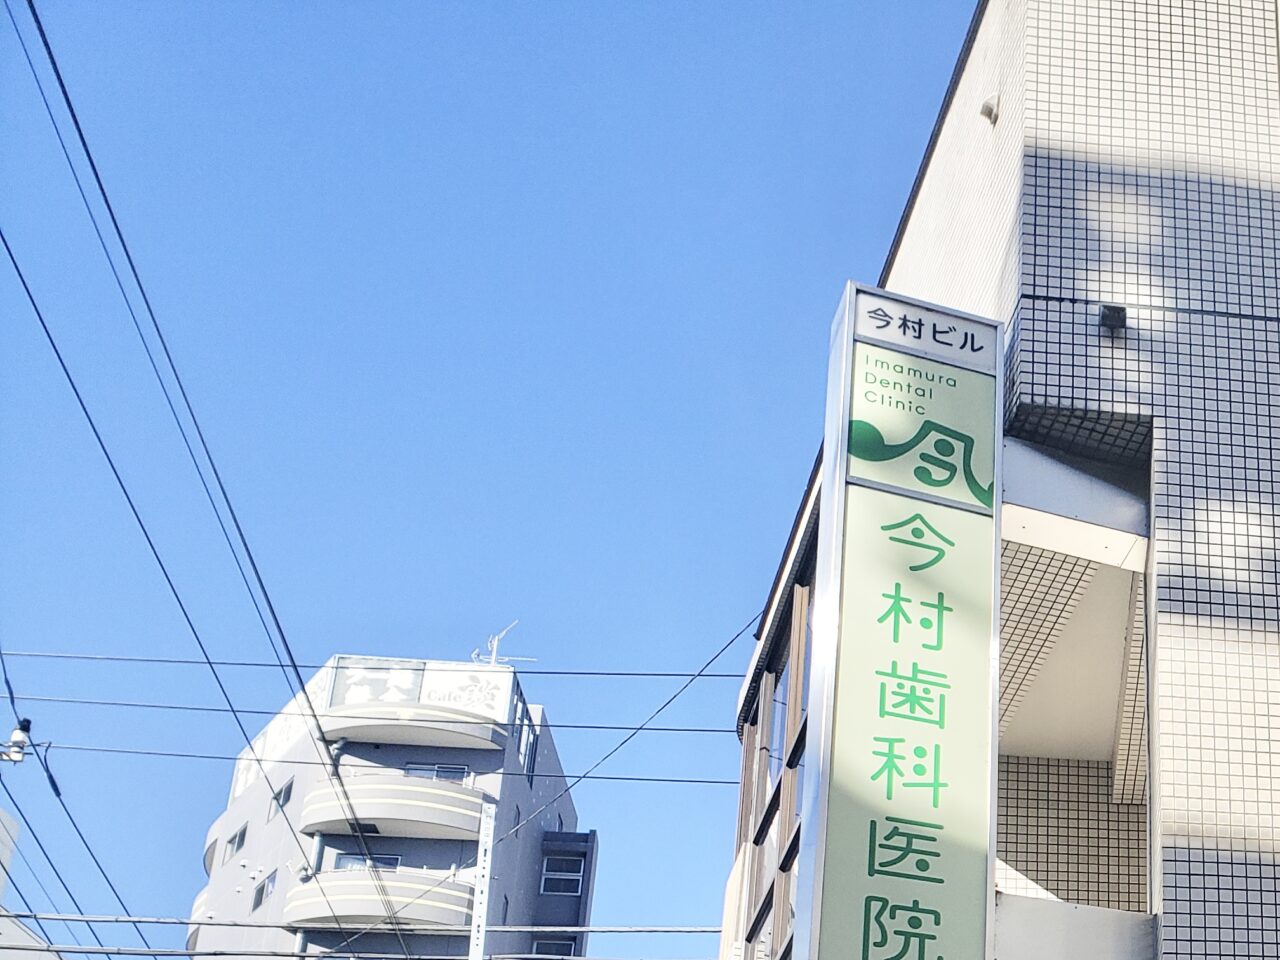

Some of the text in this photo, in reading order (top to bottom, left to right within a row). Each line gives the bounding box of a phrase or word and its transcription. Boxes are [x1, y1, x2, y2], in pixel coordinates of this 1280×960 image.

[867, 307, 984, 352] 今村ビル
[865, 372, 933, 399] Dental
[866, 355, 957, 388] Imamura
[865, 391, 926, 415] Clinic
